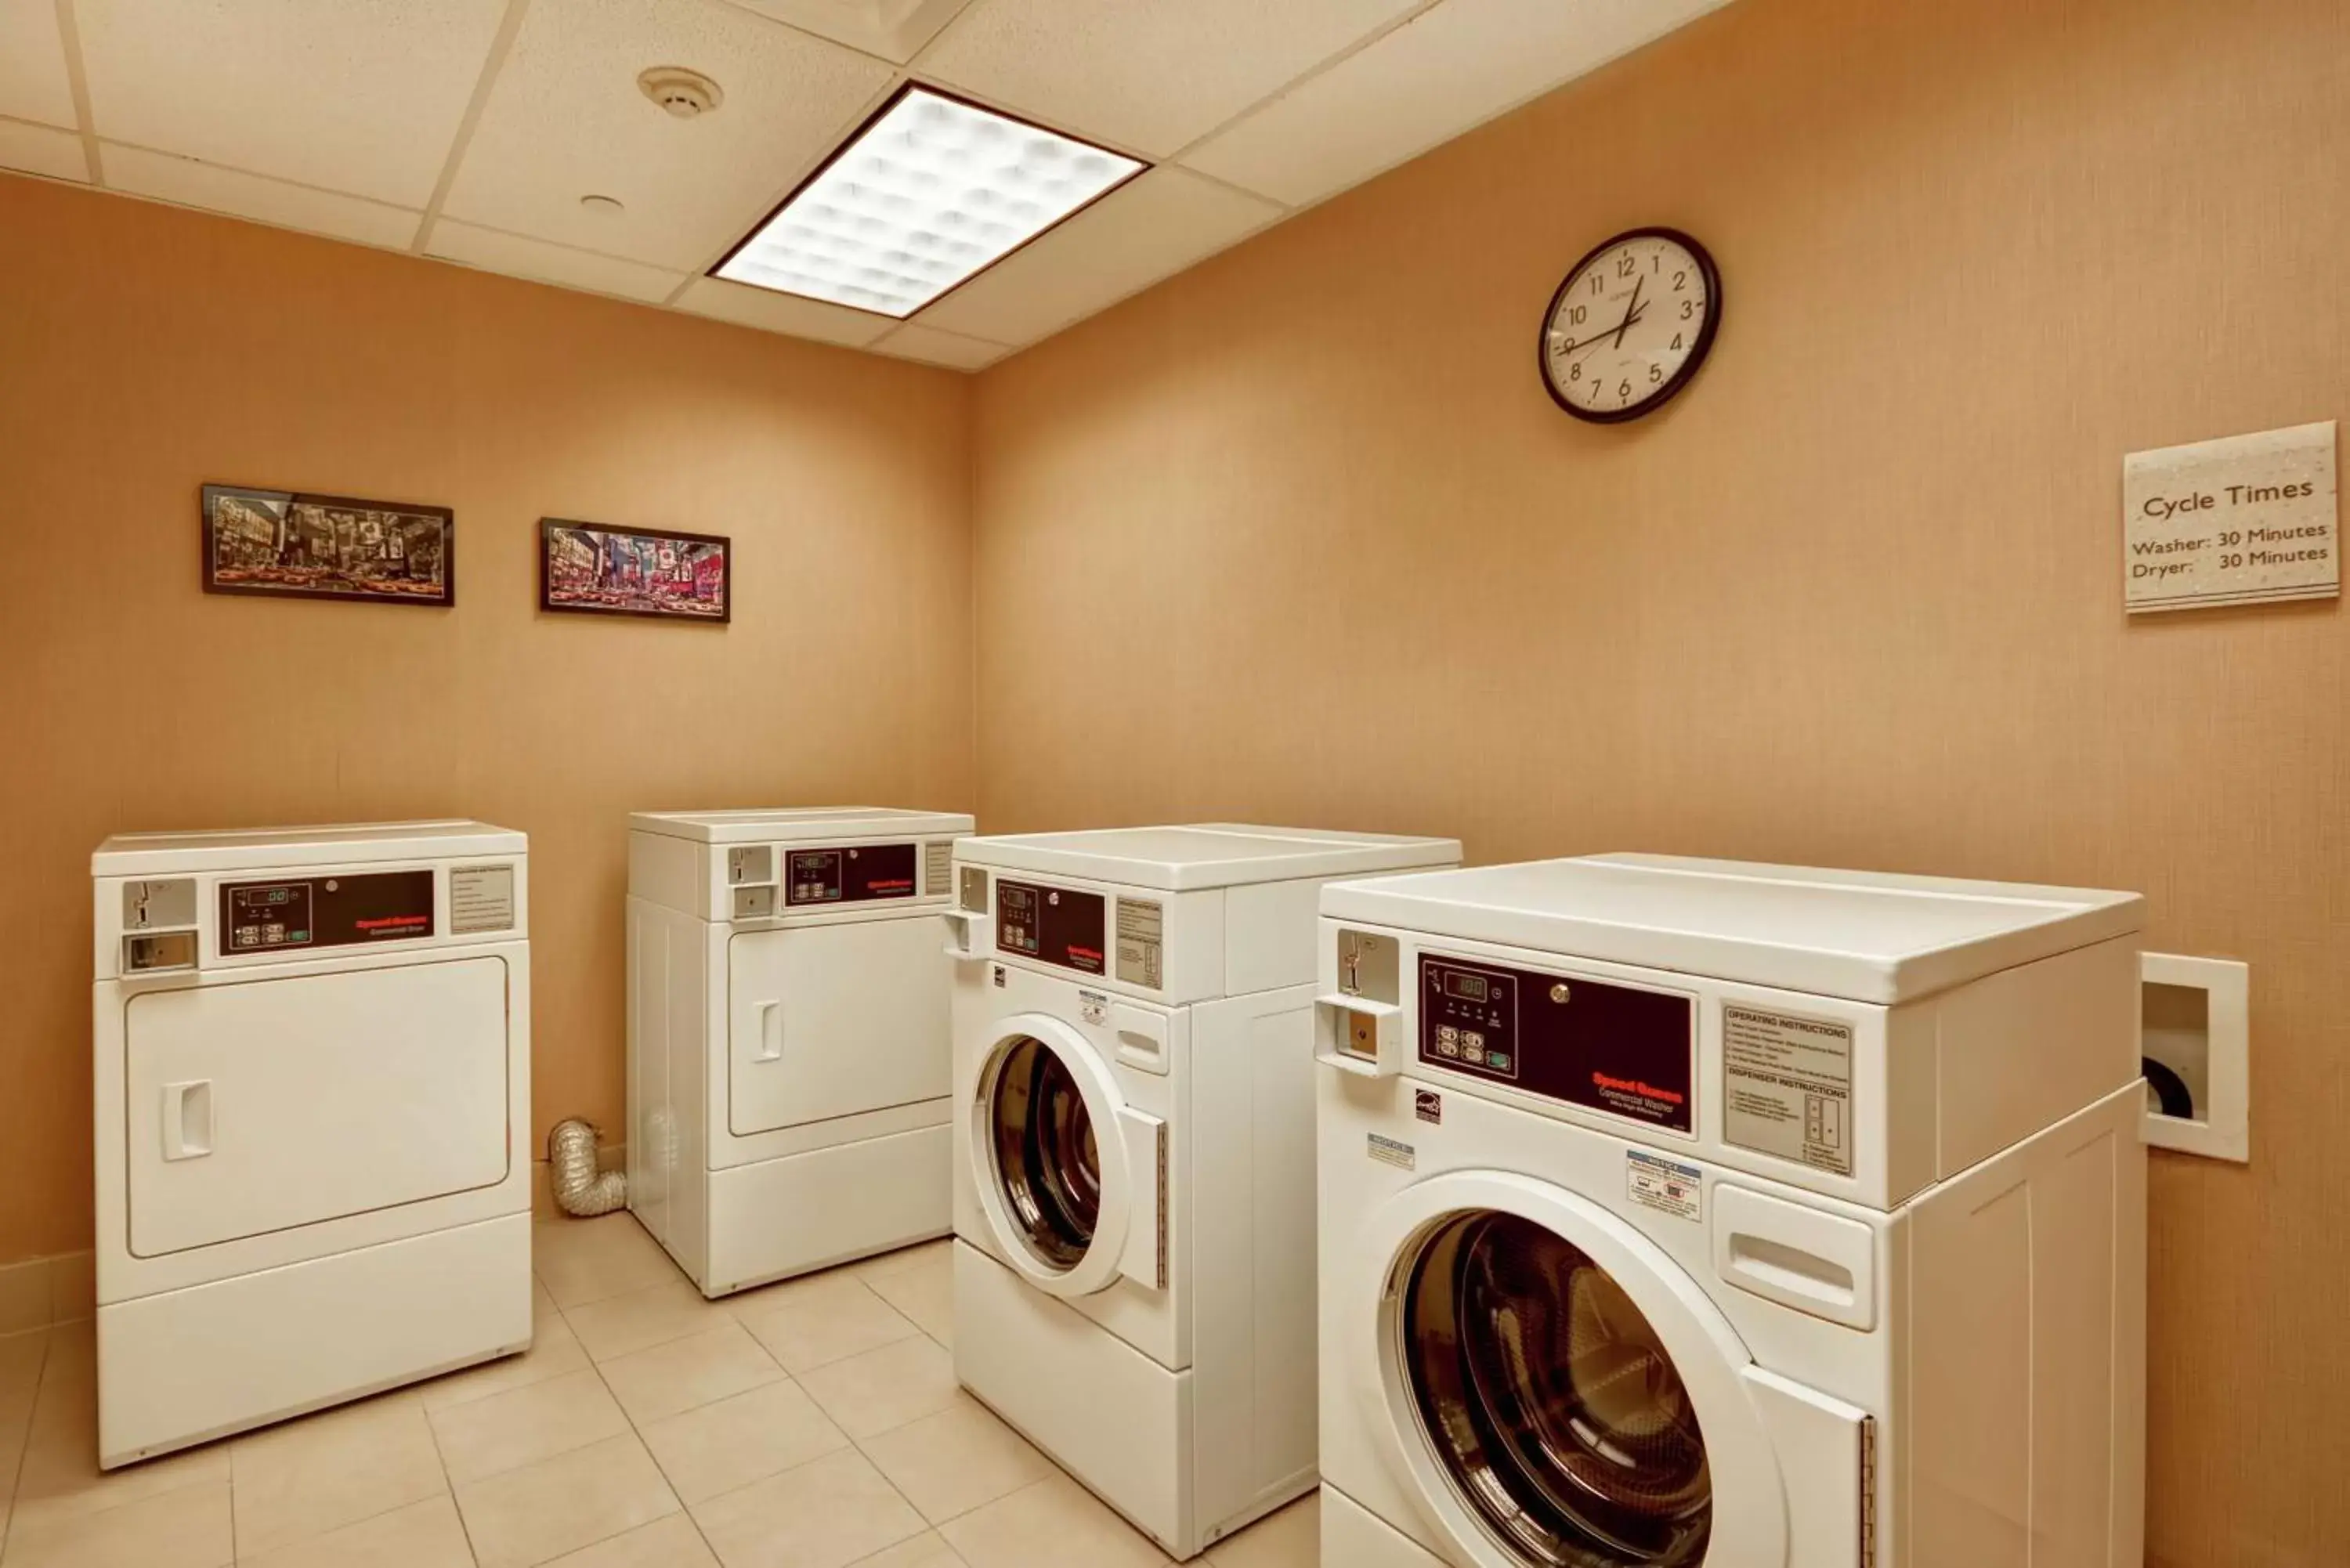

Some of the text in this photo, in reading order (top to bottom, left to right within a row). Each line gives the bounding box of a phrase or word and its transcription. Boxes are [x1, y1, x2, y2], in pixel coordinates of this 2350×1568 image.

[1616, 257, 1636, 278] 12
[1652, 255, 1659, 274] 1
[1590, 275, 1603, 295] 11
[1672, 270, 1687, 291] 2
[1568, 305, 1587, 327] 10
[1679, 300, 1694, 320] 3
[1564, 337, 1576, 356] 9
[1669, 332, 1683, 351] 4
[1570, 362, 1582, 381] 8
[1649, 363, 1662, 383] 5
[1591, 379, 1602, 399] 7
[1618, 378, 1632, 397] 6
[2143, 481, 2314, 520] Cycle Times
[2132, 524, 2328, 556] Washer: 30 Minutes
[2132, 547, 2329, 580] Dryer: 30 Minutes
[1728, 1010, 1777, 1027] OPERATING
[1779, 1017, 1847, 1039] INSTRUCTIONS
[1728, 1067, 1777, 1083] DISPENSER
[1779, 1078, 1847, 1099] INSTRUCTIONS
